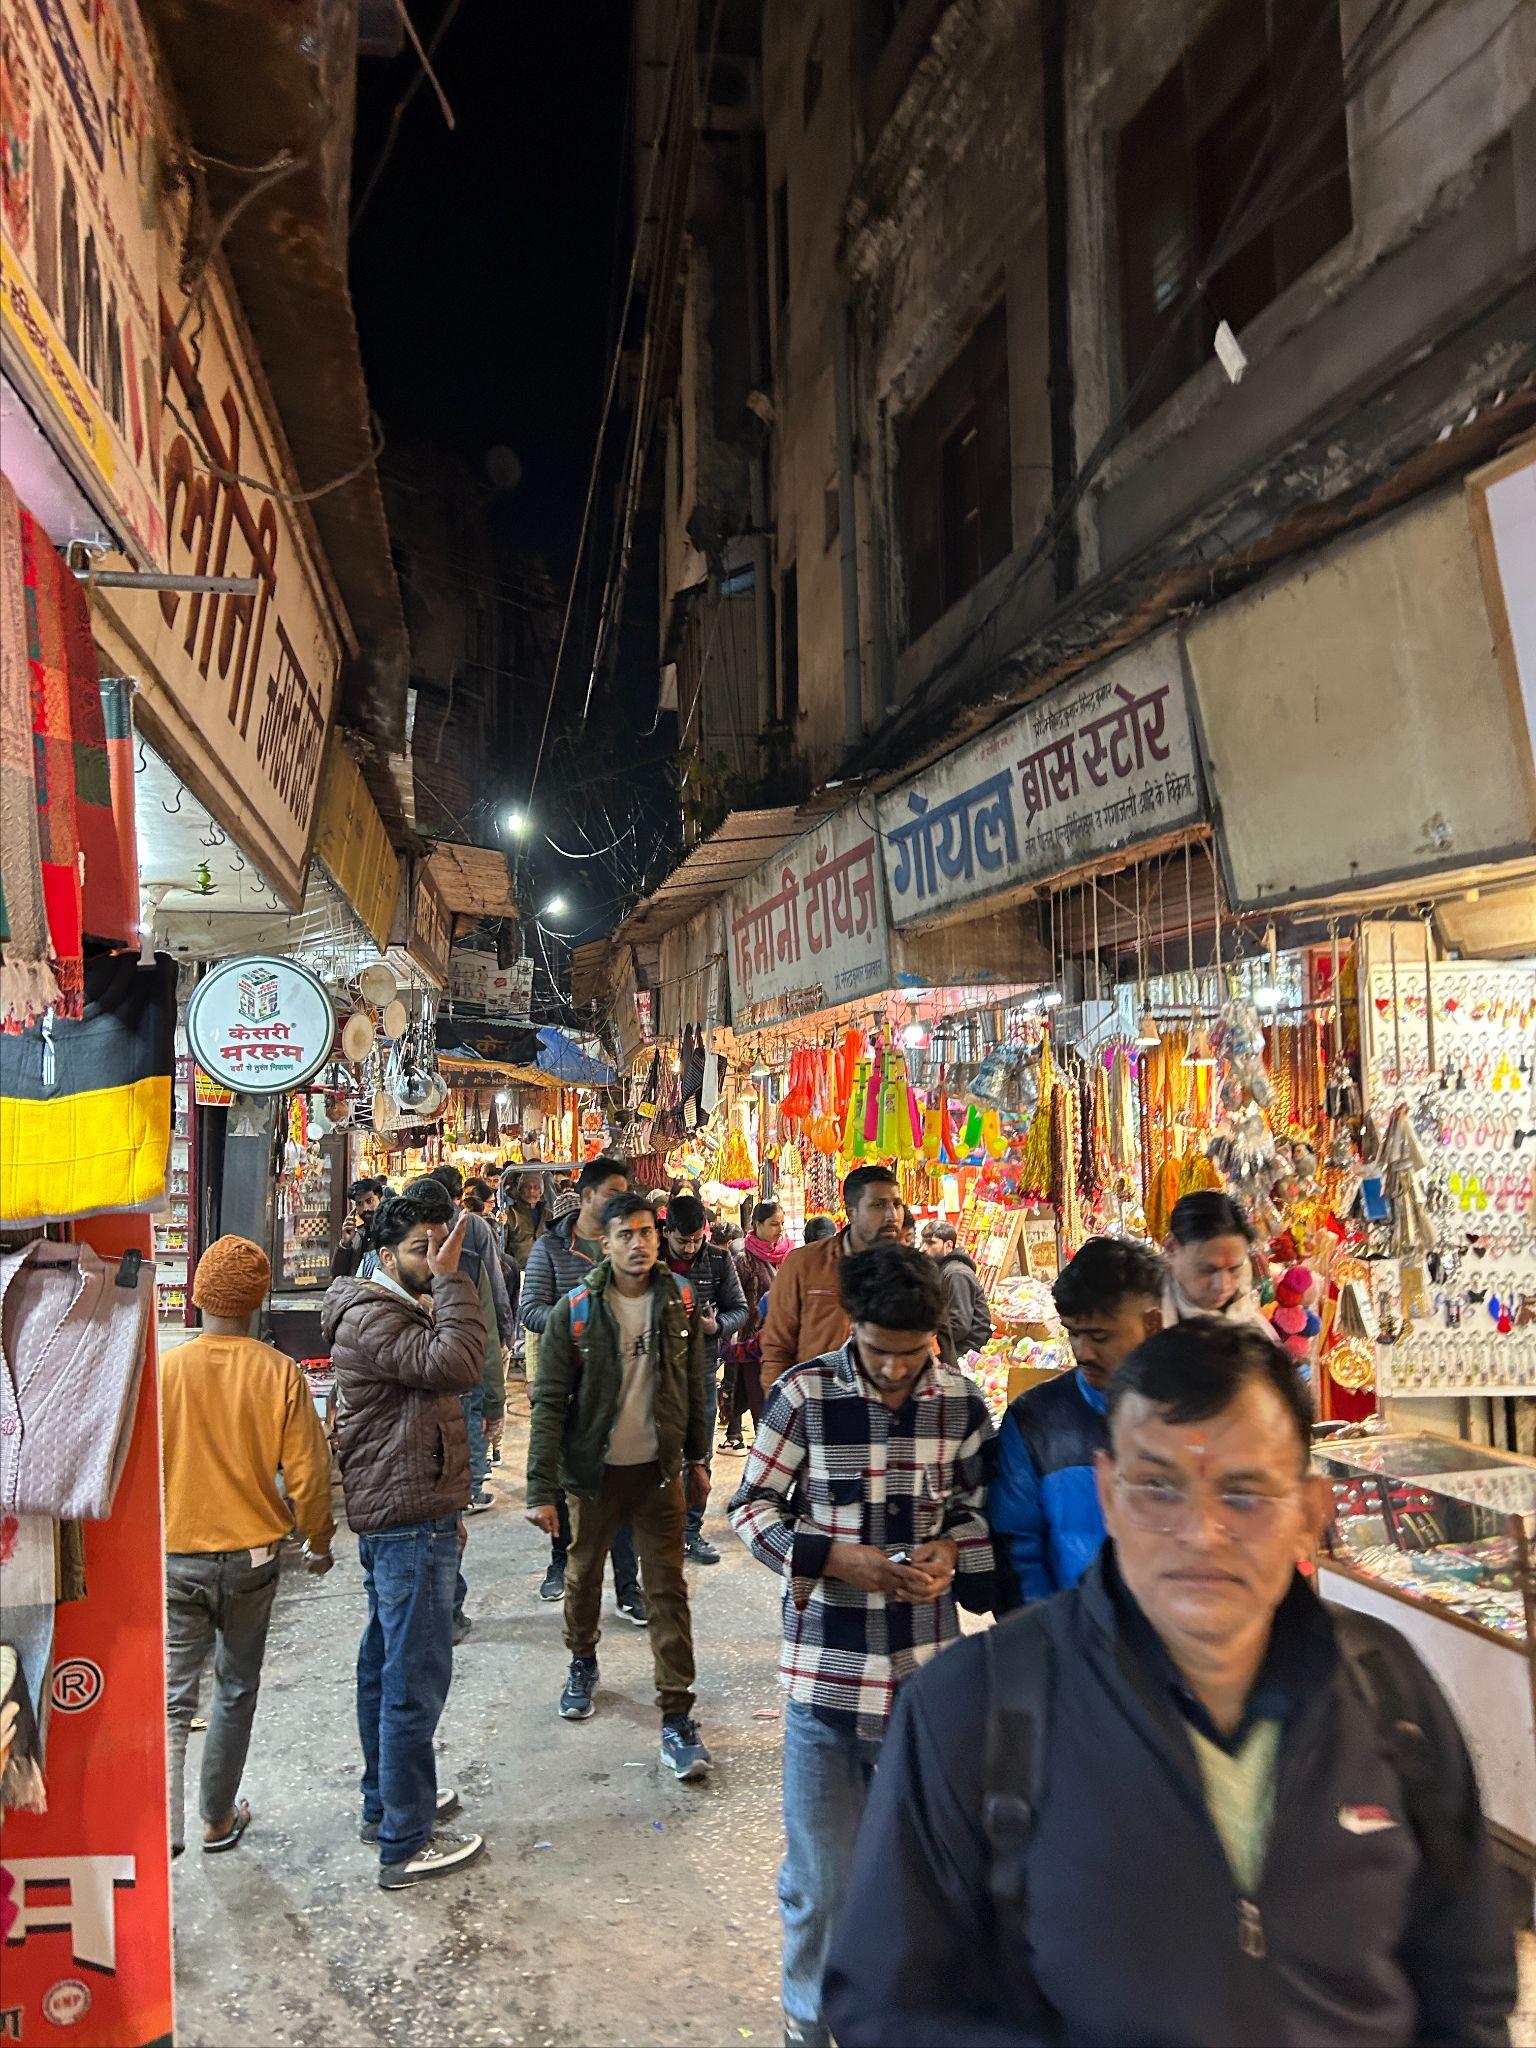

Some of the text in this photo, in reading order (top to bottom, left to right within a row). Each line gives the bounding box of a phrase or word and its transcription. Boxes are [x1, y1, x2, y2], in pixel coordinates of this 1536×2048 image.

[256, 615, 326, 834] जनरल स्टोर
[1016, 683, 1170, 828] ब्रास स्टोर
[888, 768, 1019, 899] गोयल
[732, 866, 800, 990] हिमानी
[219, 1043, 305, 1063] मरहम
[228, 1022, 291, 1040] केसरी
